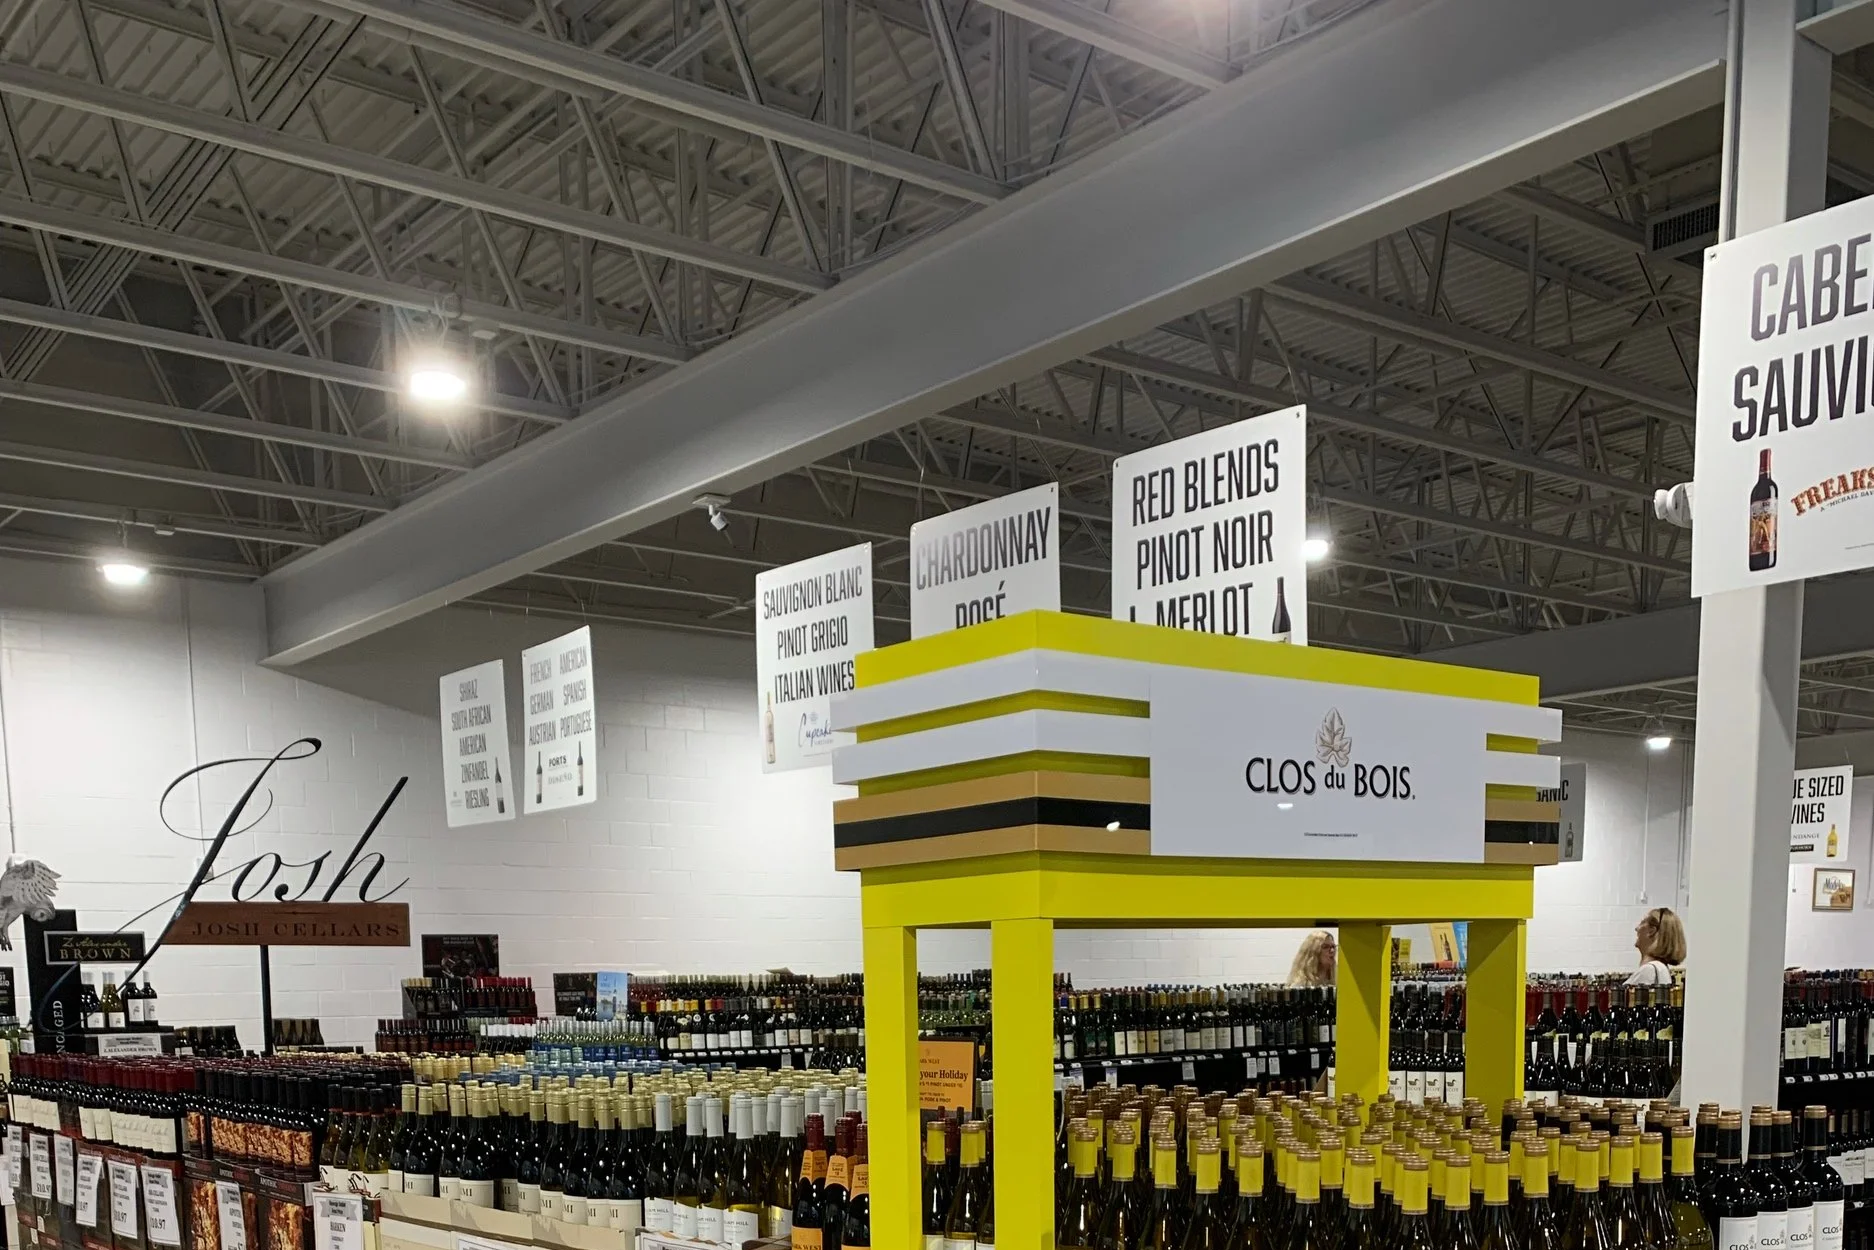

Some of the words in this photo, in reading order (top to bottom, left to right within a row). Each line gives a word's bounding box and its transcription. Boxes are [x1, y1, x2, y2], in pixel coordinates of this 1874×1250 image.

[1750, 232, 1874, 342] CABE
[1732, 333, 1874, 442] SAUVI
[1132, 463, 1174, 526] RED
[1184, 439, 1279, 512] BLENDS
[916, 507, 1052, 590] CHARDONNAY
[1137, 525, 1204, 590] PINOT
[1214, 509, 1274, 573] NOIR
[764, 575, 822, 620] SAUVIGNON
[826, 566, 863, 604] BLANC
[1156, 583, 1254, 637] MERLOT
[778, 624, 807, 660] PINOT
[811, 615, 848, 653] GRIGIO
[530, 657, 552, 684] FRENCH
[560, 645, 587, 674] AMERICAN
[460, 679, 478, 701] SHIRAZ
[564, 679, 586, 705] SPANISH
[775, 668, 813, 704] ITALIAN
[817, 659, 854, 696] WINES
[530, 690, 553, 715] GERMAN
[452, 709, 467, 731] SOUTH
[469, 704, 491, 727] AFRICAN
[560, 709, 592, 739] PORTUGUESE
[460, 733, 487, 756] AMERICAN
[529, 720, 556, 745] AUSTRIAN
[461, 761, 489, 783] ZINFANDEL
[549, 755, 566, 766] PORTS
[1246, 757, 1316, 795] CLOS
[1324, 768, 1346, 790] du
[1809, 776, 1843, 797] SIZED
[465, 788, 489, 809] RIESLING
[191, 922, 259, 937] JOSH
[274, 922, 399, 937] CELLARS
[60, 948, 130, 959] BROWN
[920, 1071, 938, 1080] your
[939, 1070, 968, 1082] Holiday
